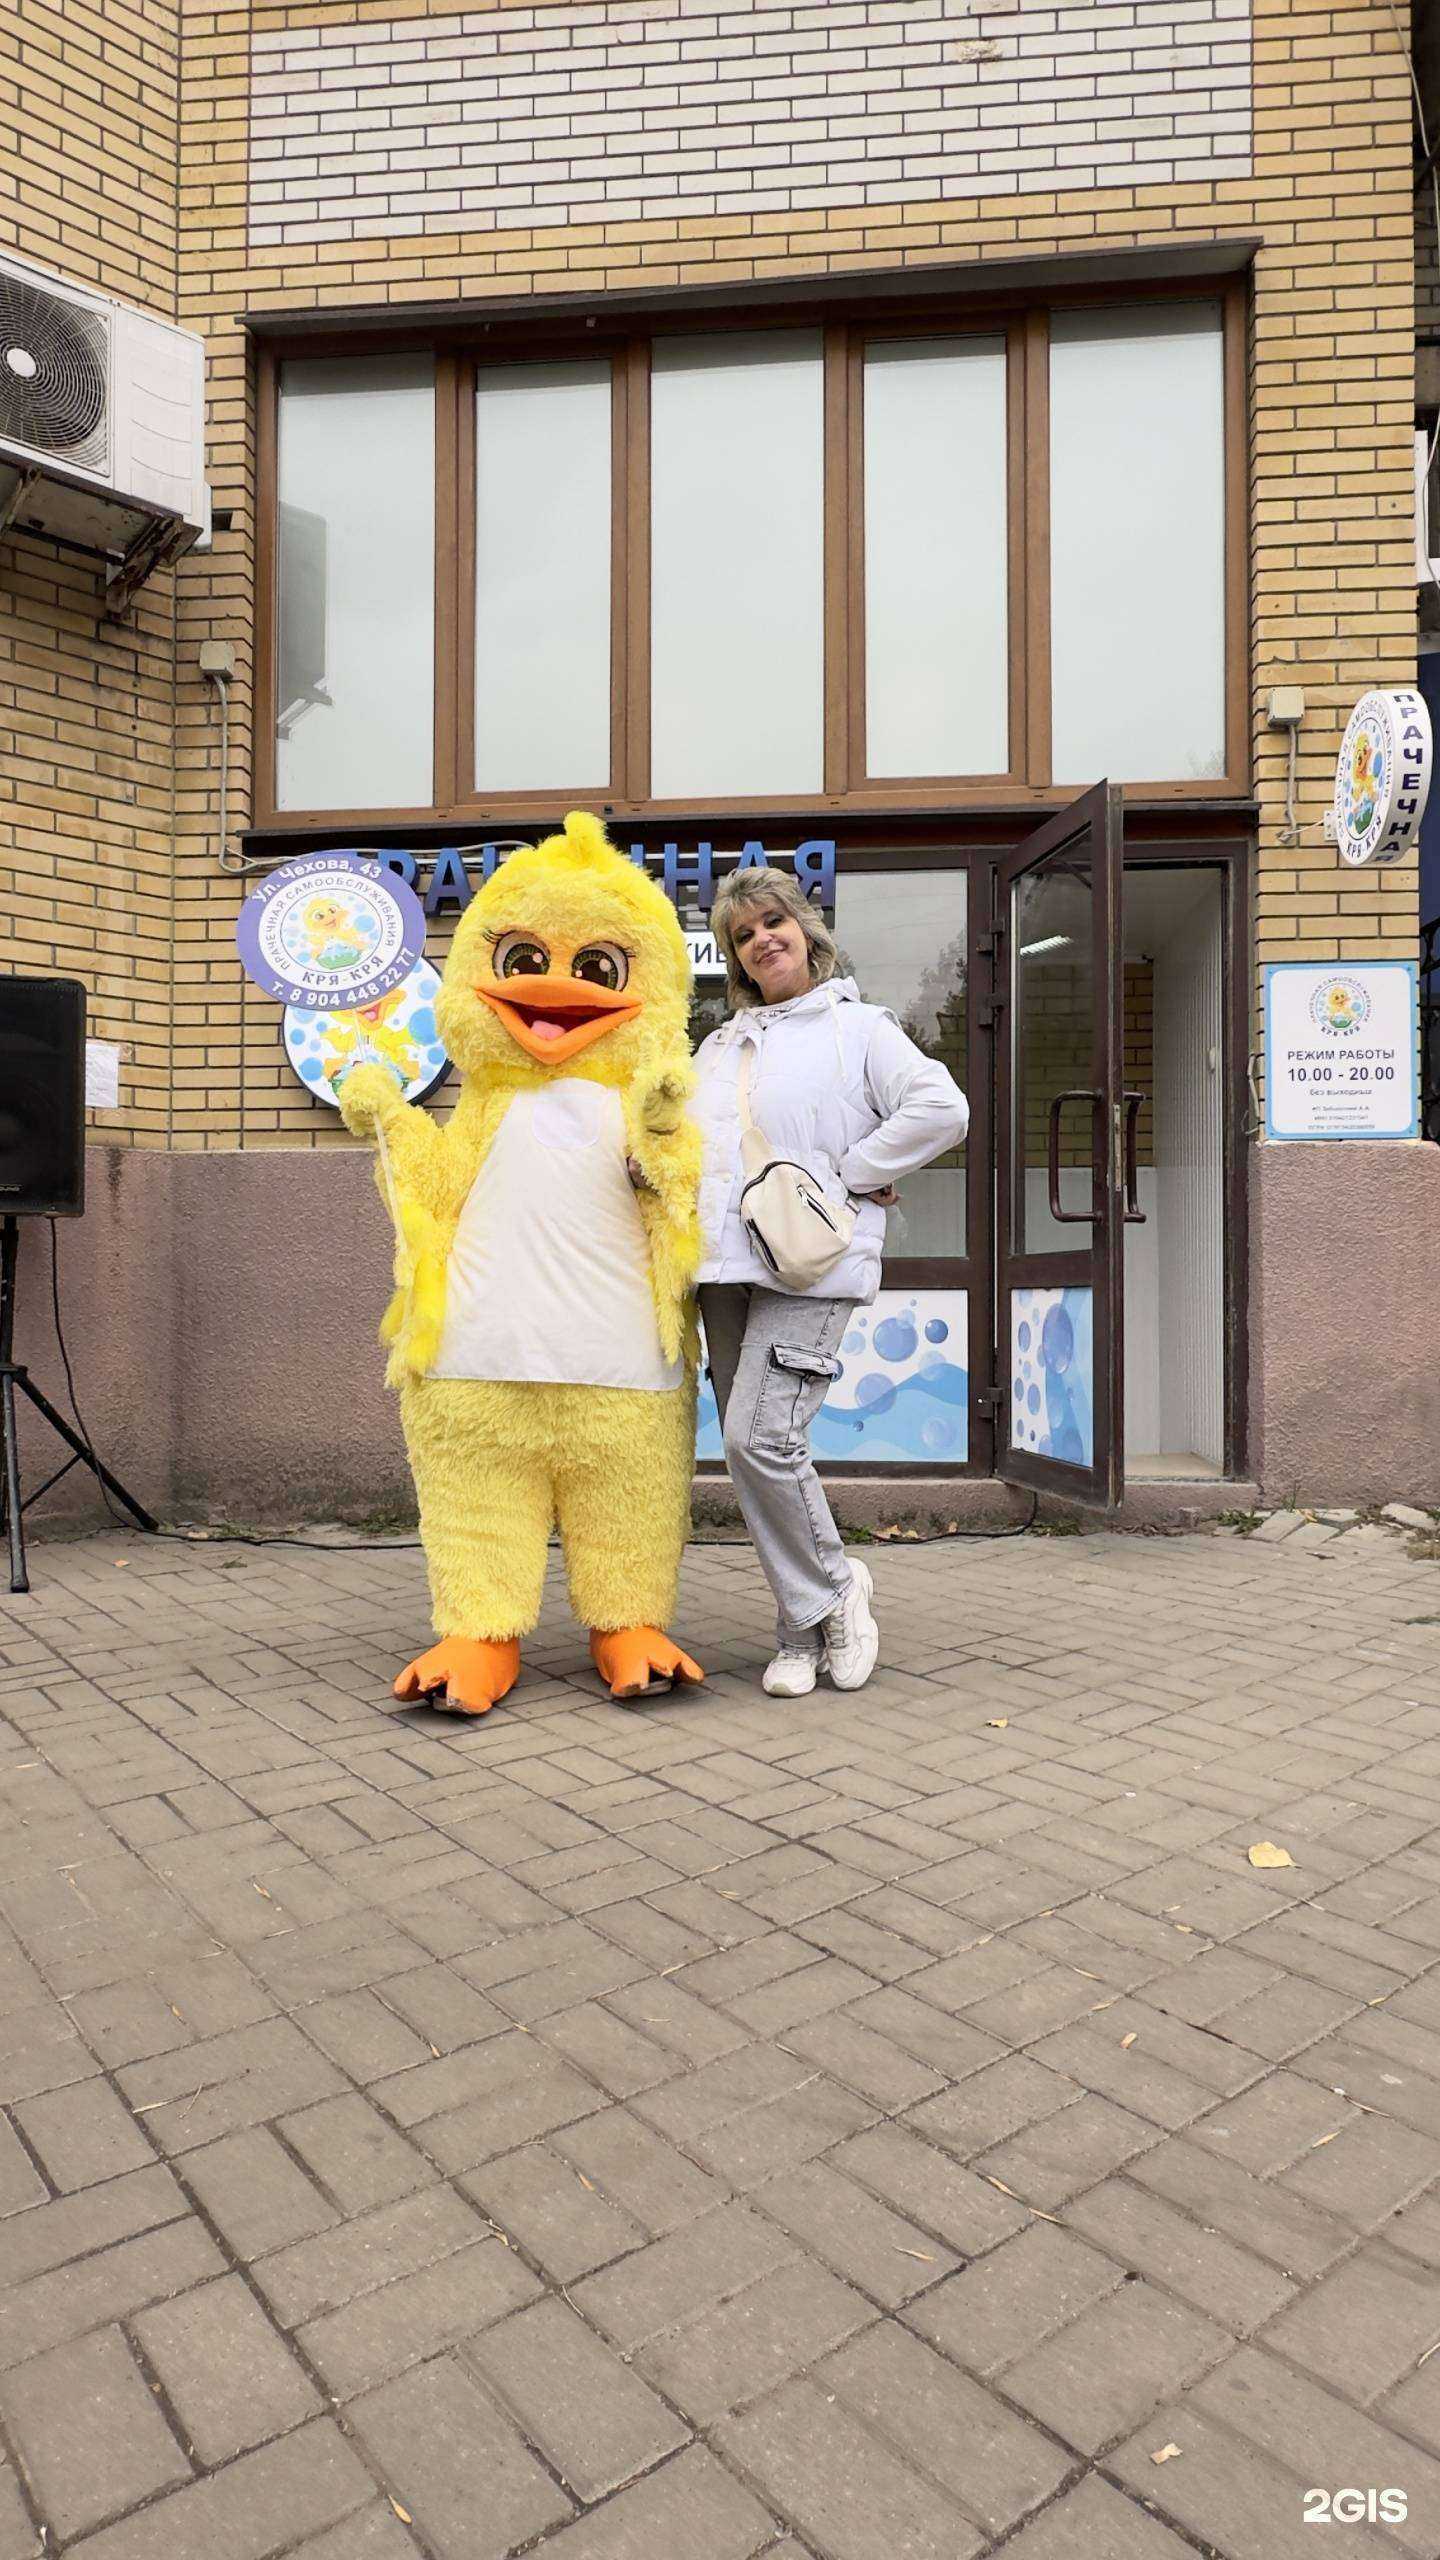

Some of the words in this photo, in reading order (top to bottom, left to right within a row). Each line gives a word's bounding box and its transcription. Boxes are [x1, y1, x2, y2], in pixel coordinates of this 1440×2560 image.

[1374, 694, 1424, 862] ПРАЧЕЧНАЯ
[279, 859, 354, 879] Чехова,
[360, 862, 382, 879] 43
[265, 900, 290, 971] ПРАЧЕЧНАЯ
[286, 877, 397, 947] САМООБСЛУЖИВАНИЯ
[289, 988, 302, 1002] 8
[306, 994, 340, 1007] 904
[346, 982, 380, 1003] 448
[380, 967, 402, 988] 22
[1287, 1050, 1335, 1060] РЕЖИМ
[1339, 1049, 1395, 1060] РАБОТЫ
[1288, 1067, 1332, 1081] 10.00
[1349, 1066, 1394, 1081] 20.00
